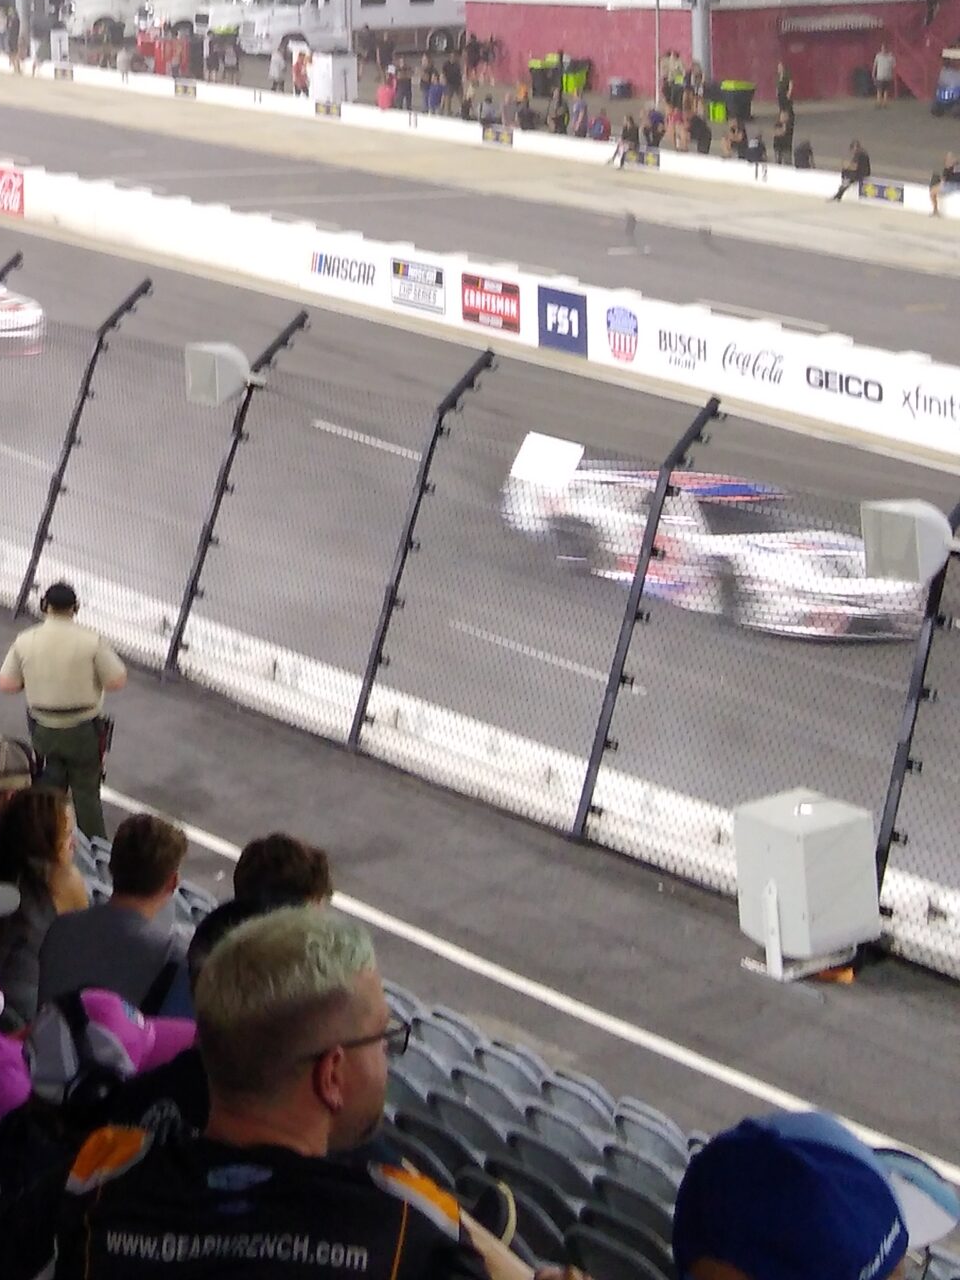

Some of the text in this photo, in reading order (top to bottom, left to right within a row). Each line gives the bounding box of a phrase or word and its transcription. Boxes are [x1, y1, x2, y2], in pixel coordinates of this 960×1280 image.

[322, 253, 376, 287] NASCAR
[463, 287, 518, 319] CRAFTSMAN
[546, 302, 580, 338] FS1
[658, 329, 707, 362] BUSCH
[805, 365, 884, 403] GEICO
[902, 384, 960, 423] xfinit
